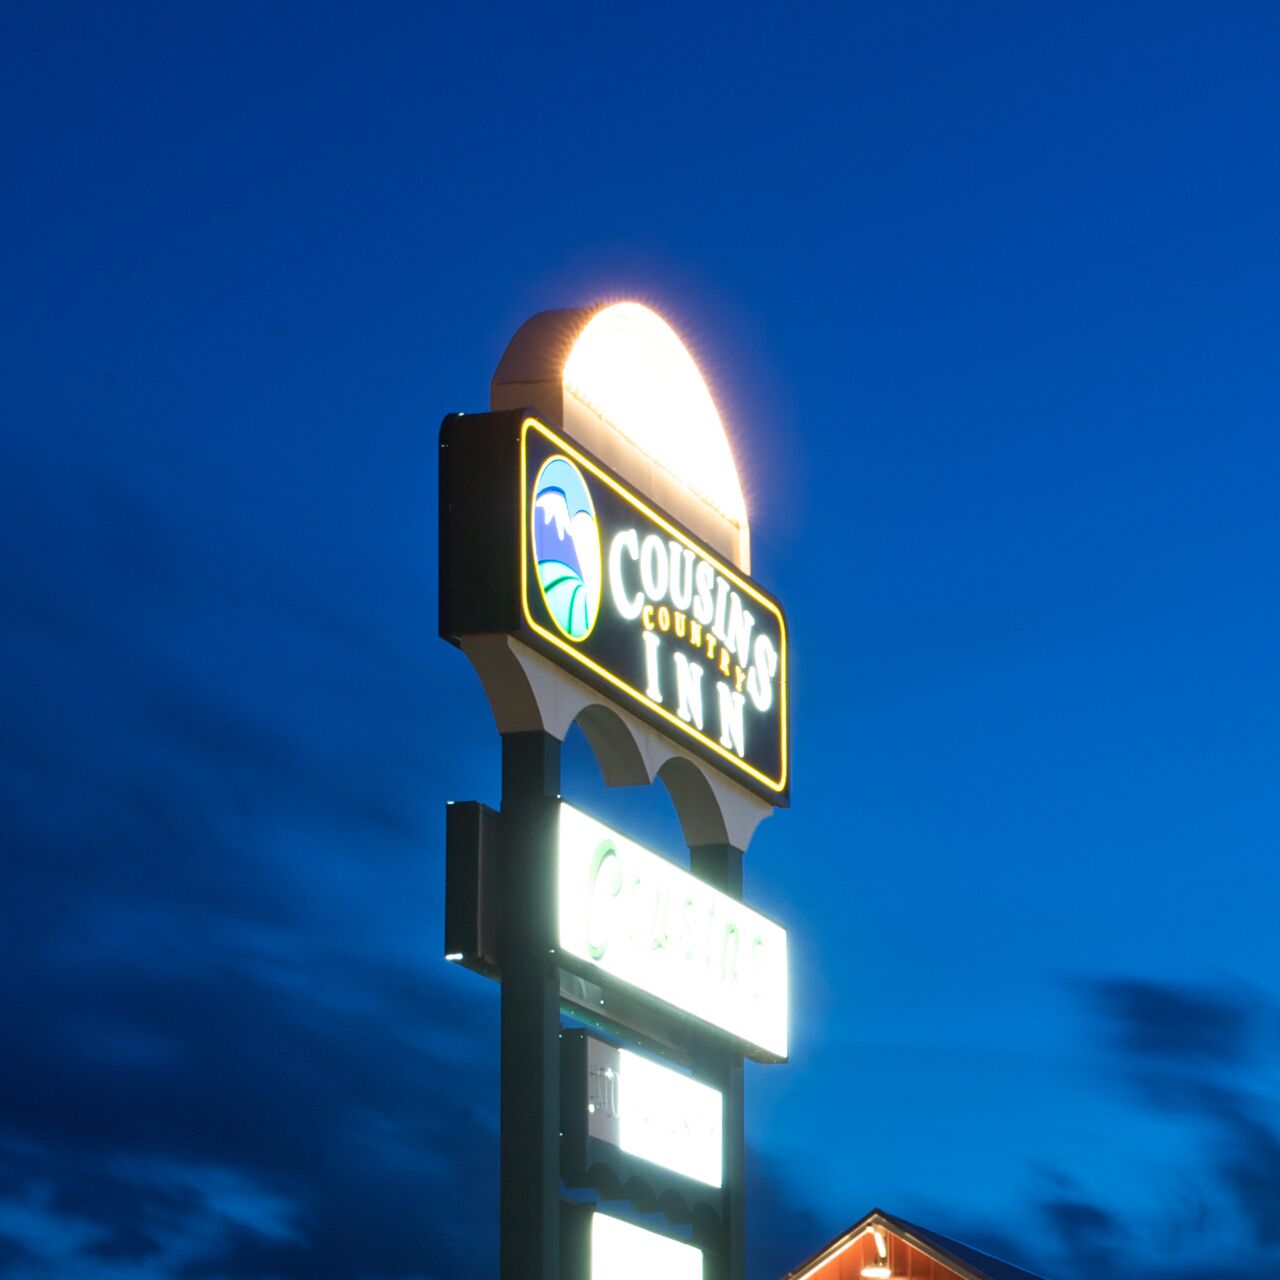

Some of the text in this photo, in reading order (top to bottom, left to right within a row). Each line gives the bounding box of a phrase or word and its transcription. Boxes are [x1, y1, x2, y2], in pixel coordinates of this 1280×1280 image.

[608, 528, 778, 712] COUSINS
[641, 604, 746, 693] COUNTRY
[642, 629, 746, 758] INN
